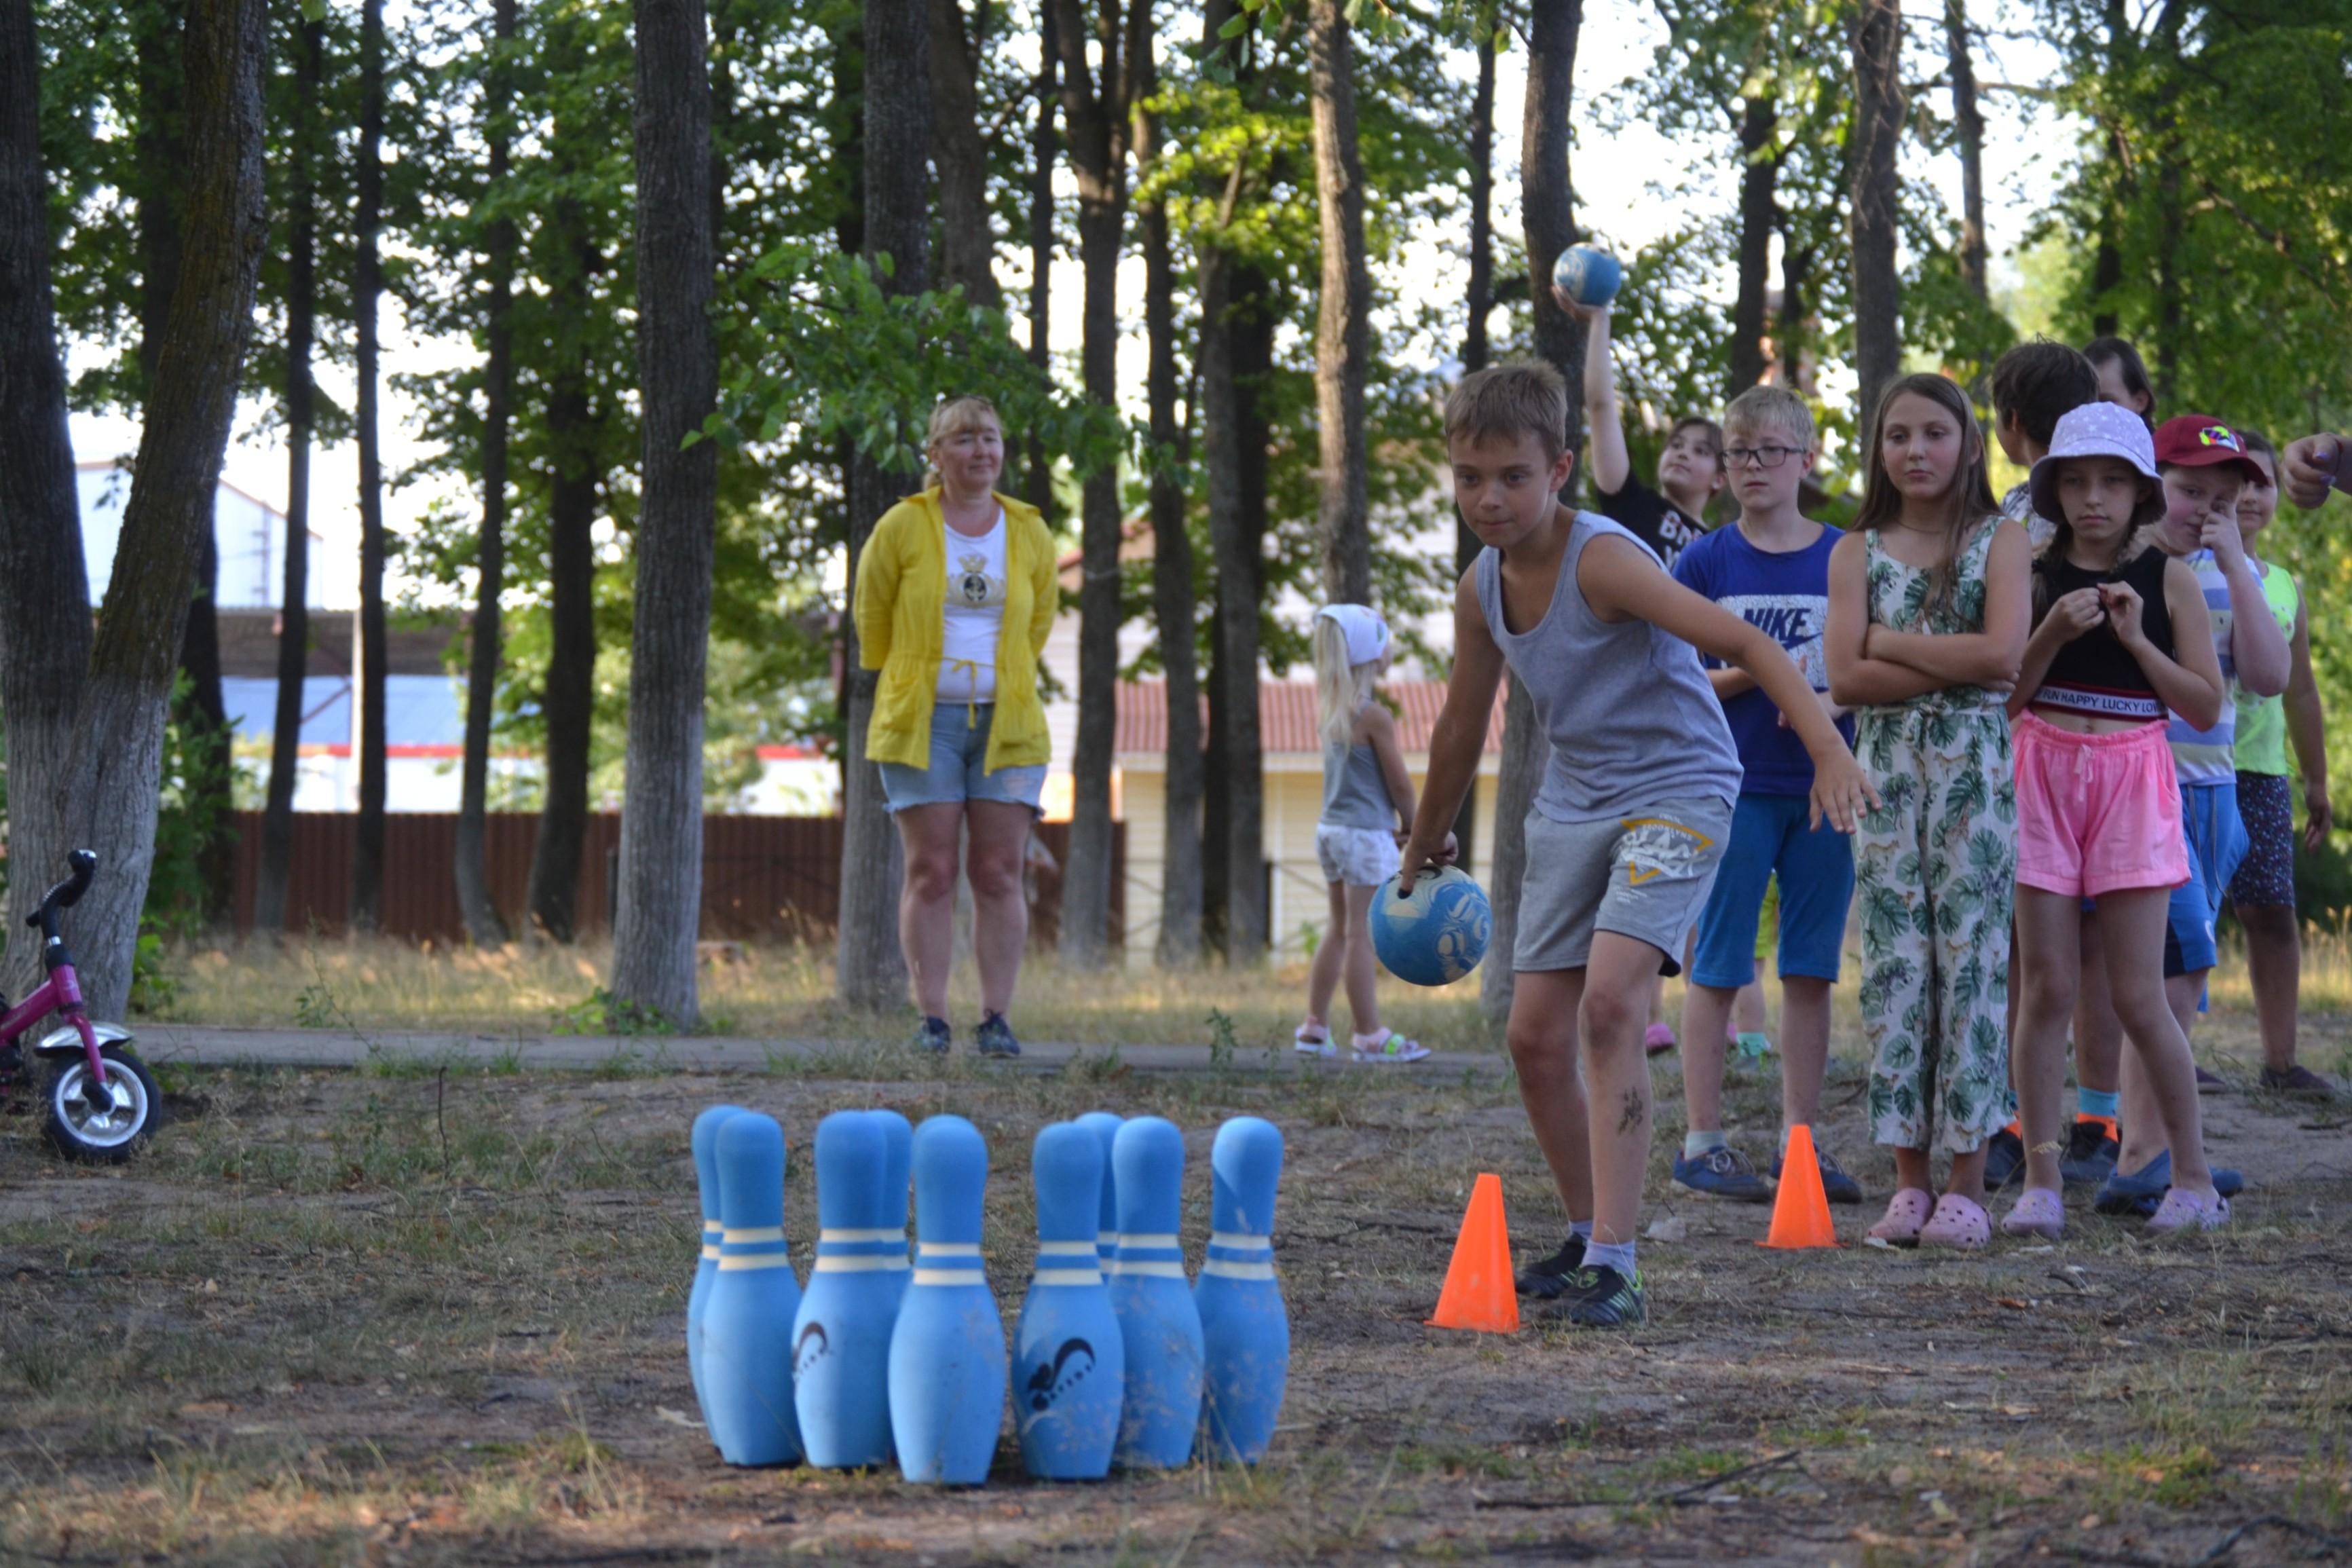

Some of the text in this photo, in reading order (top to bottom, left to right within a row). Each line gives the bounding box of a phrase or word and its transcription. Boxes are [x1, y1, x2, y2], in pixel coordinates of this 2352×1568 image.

[1743, 608, 1812, 641] NIKE
[2061, 692, 2099, 708] HAPPY
[2102, 697, 2140, 713] LUCKY
